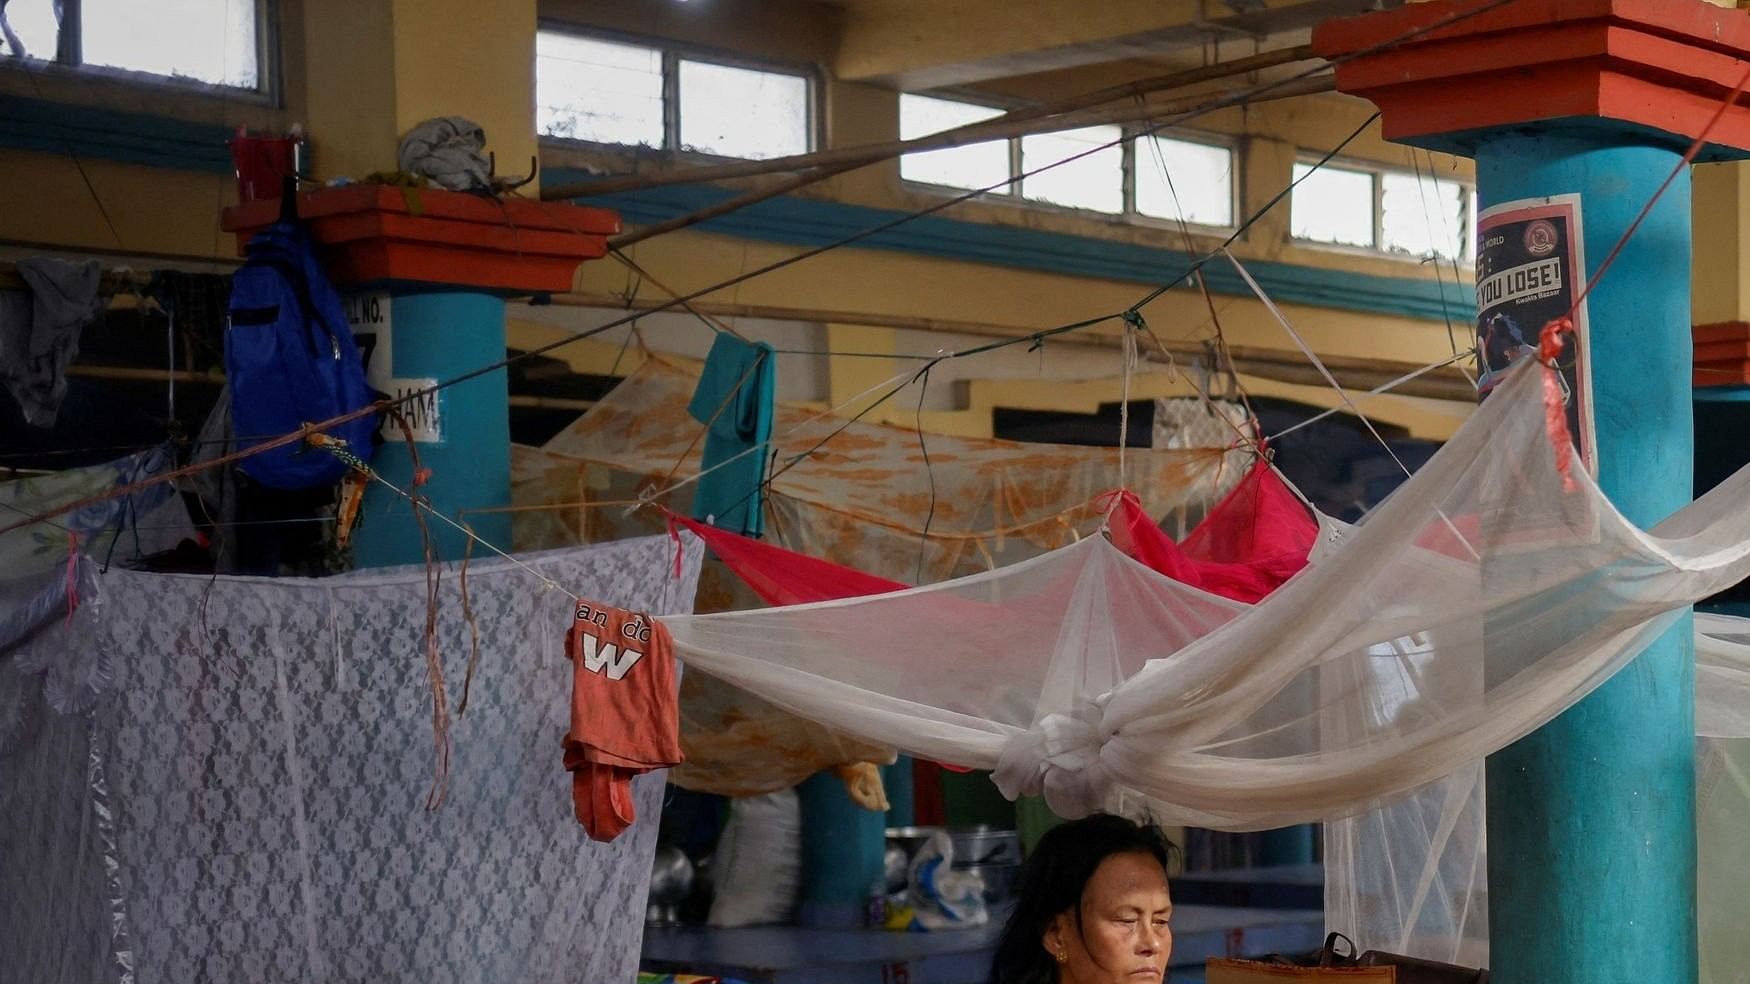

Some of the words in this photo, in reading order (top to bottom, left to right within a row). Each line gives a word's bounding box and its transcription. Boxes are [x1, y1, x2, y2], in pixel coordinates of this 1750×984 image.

[1481, 278, 1502, 306] YOU
[1507, 262, 1560, 295] LOSE!
[581, 631, 644, 681] W
